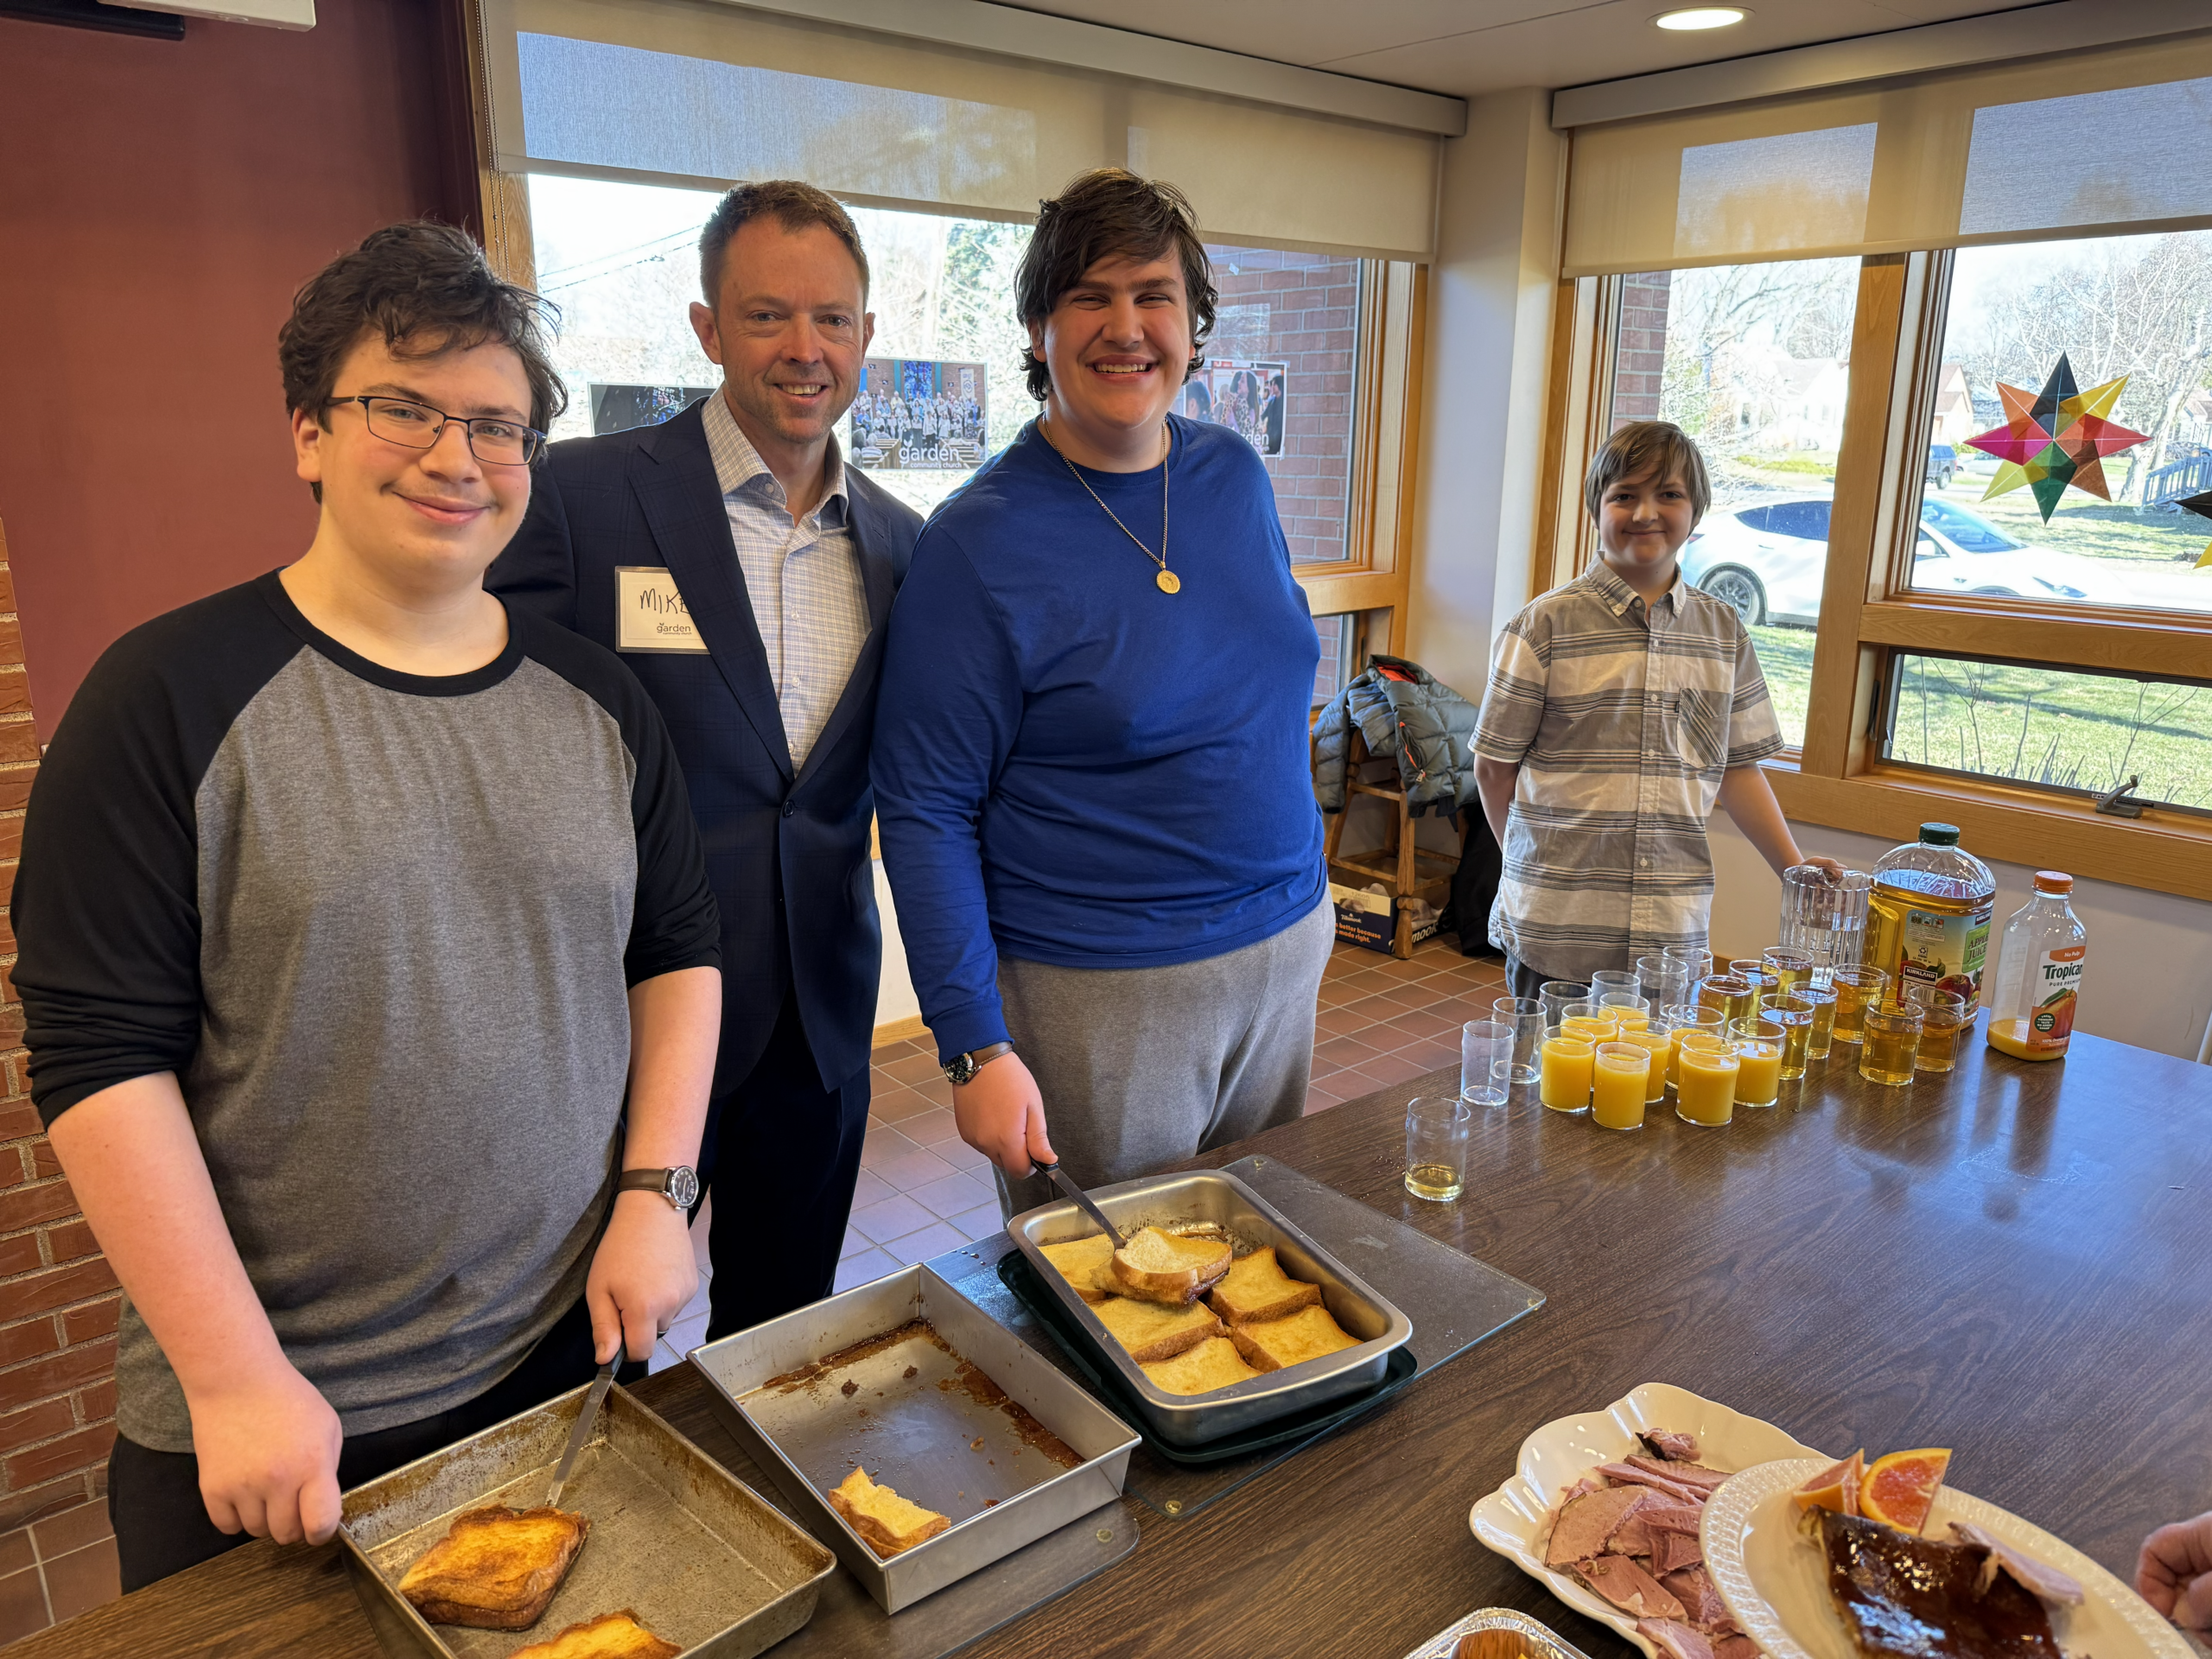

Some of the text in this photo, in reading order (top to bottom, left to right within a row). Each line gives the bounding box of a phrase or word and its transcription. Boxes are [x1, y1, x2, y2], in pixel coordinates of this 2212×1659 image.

[899, 443, 959, 464] garden
[657, 624, 691, 633] garden
[1338, 922, 1357, 933] better
[1357, 927, 1382, 940] because
[1338, 929, 1355, 939] made
[1355, 934, 1371, 944] right.
[1968, 932, 1989, 949] APPLE
[1967, 944, 1987, 963] JUICE
[1906, 969, 1936, 979] KIRKLAND
